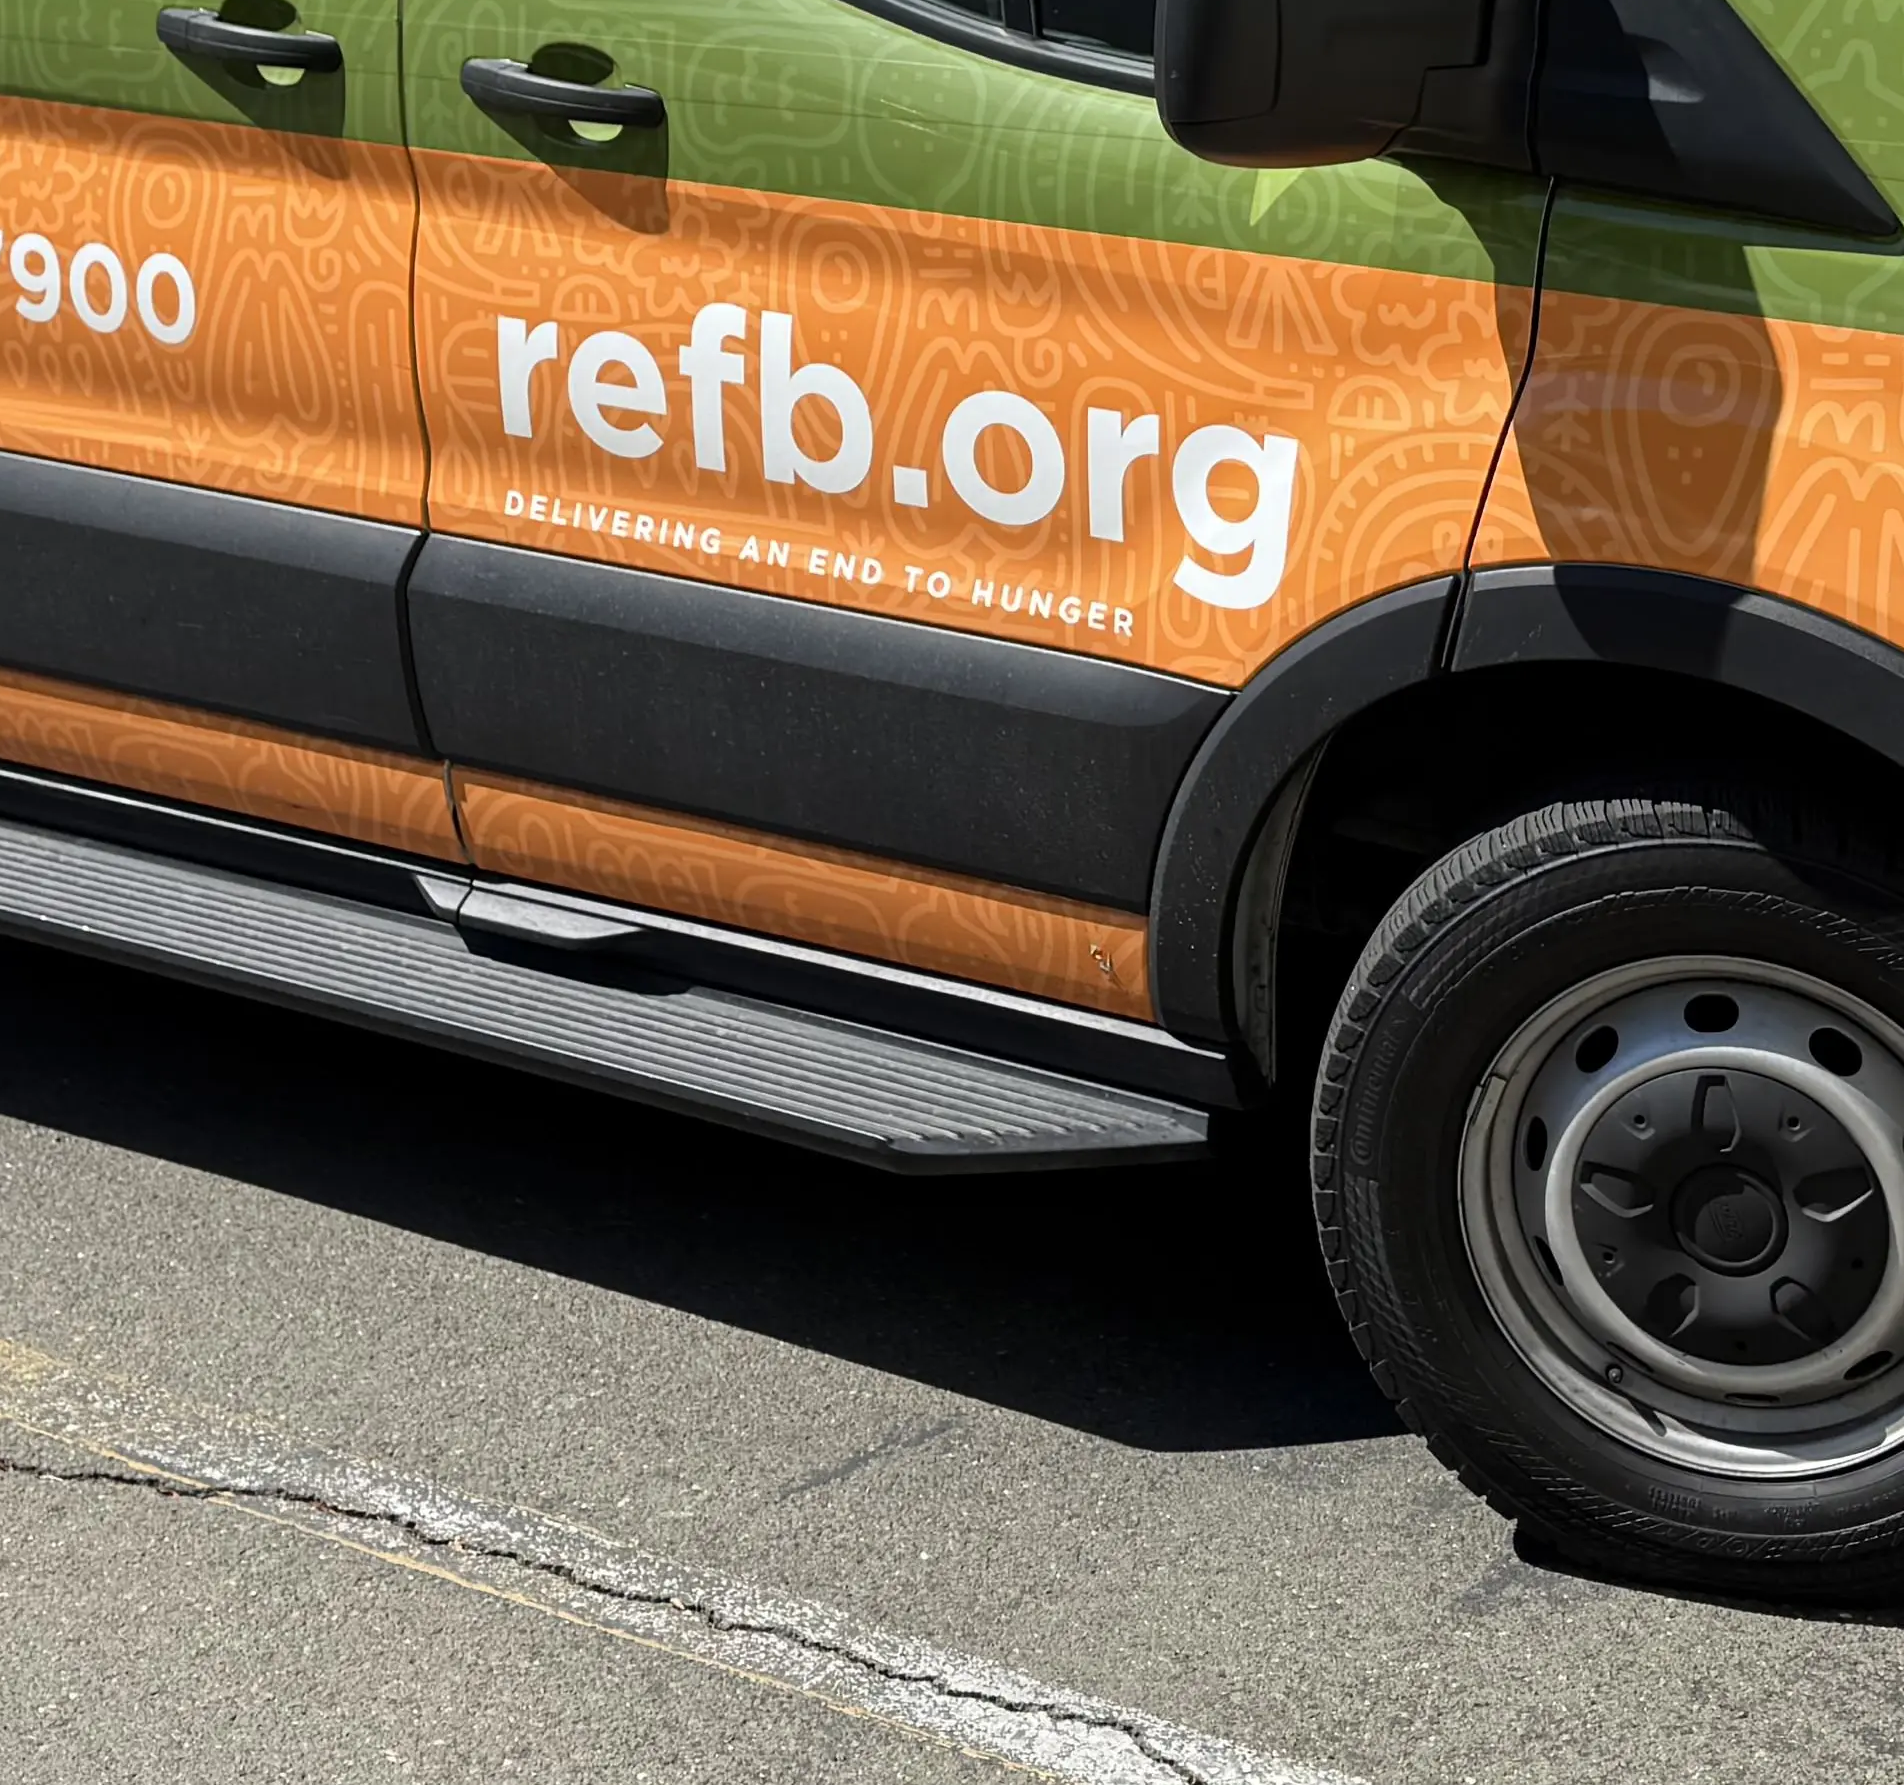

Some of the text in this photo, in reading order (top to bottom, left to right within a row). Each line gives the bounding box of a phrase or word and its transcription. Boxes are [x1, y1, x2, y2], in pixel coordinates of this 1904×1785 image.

[497, 302, 1300, 610] refb.org
[503, 490, 1135, 637] DELIVERING AN END TO HUNGER
[1349, 1030, 1400, 1166] Continental
